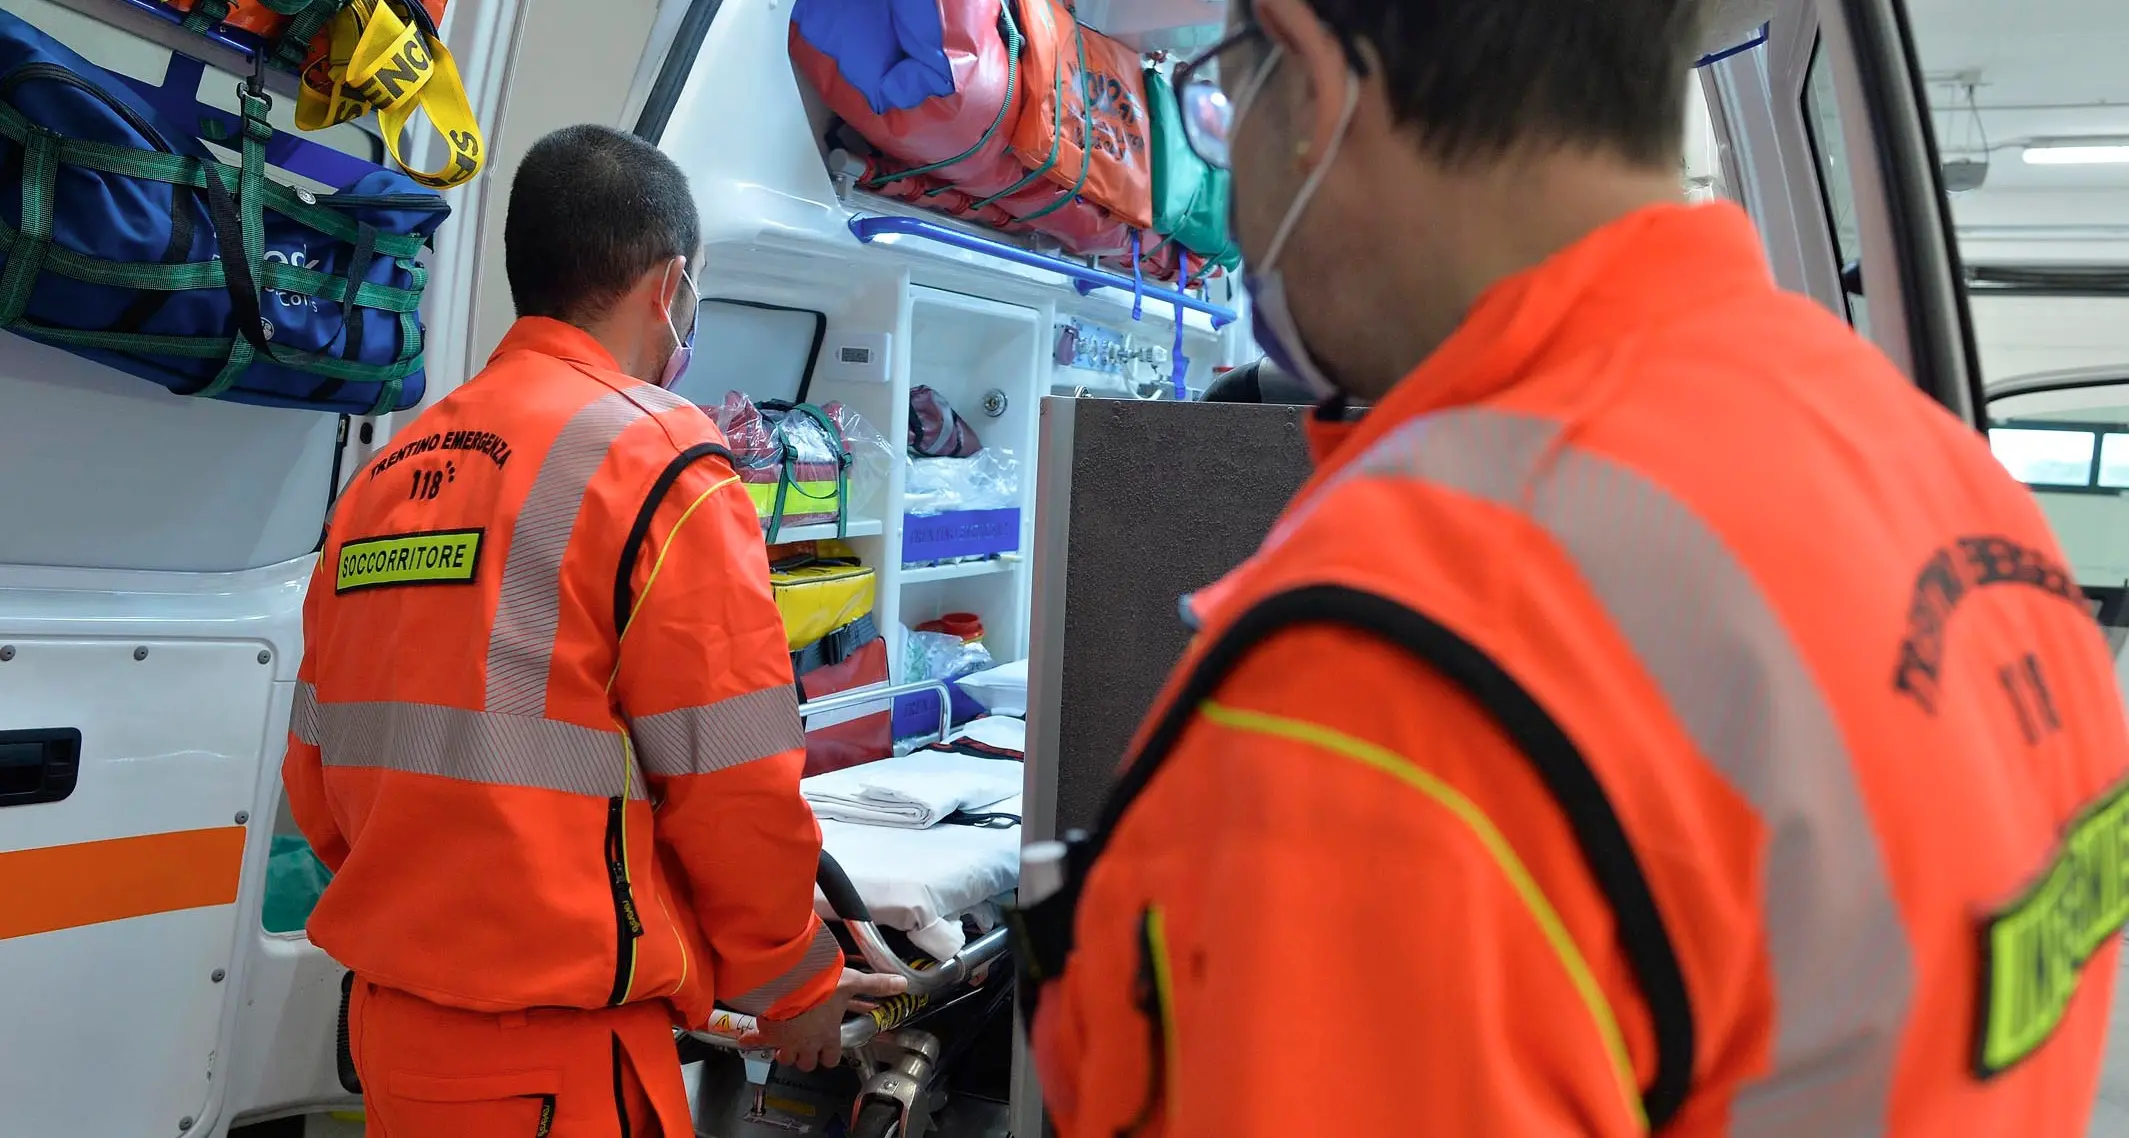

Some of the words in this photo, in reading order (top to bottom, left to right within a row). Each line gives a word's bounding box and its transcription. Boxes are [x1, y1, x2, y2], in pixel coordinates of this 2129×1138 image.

[369, 433, 441, 481] TRENTINO
[440, 430, 513, 470] EMERGENZA
[408, 469, 443, 500] 118
[341, 544, 467, 579] SOCCORRITORE
